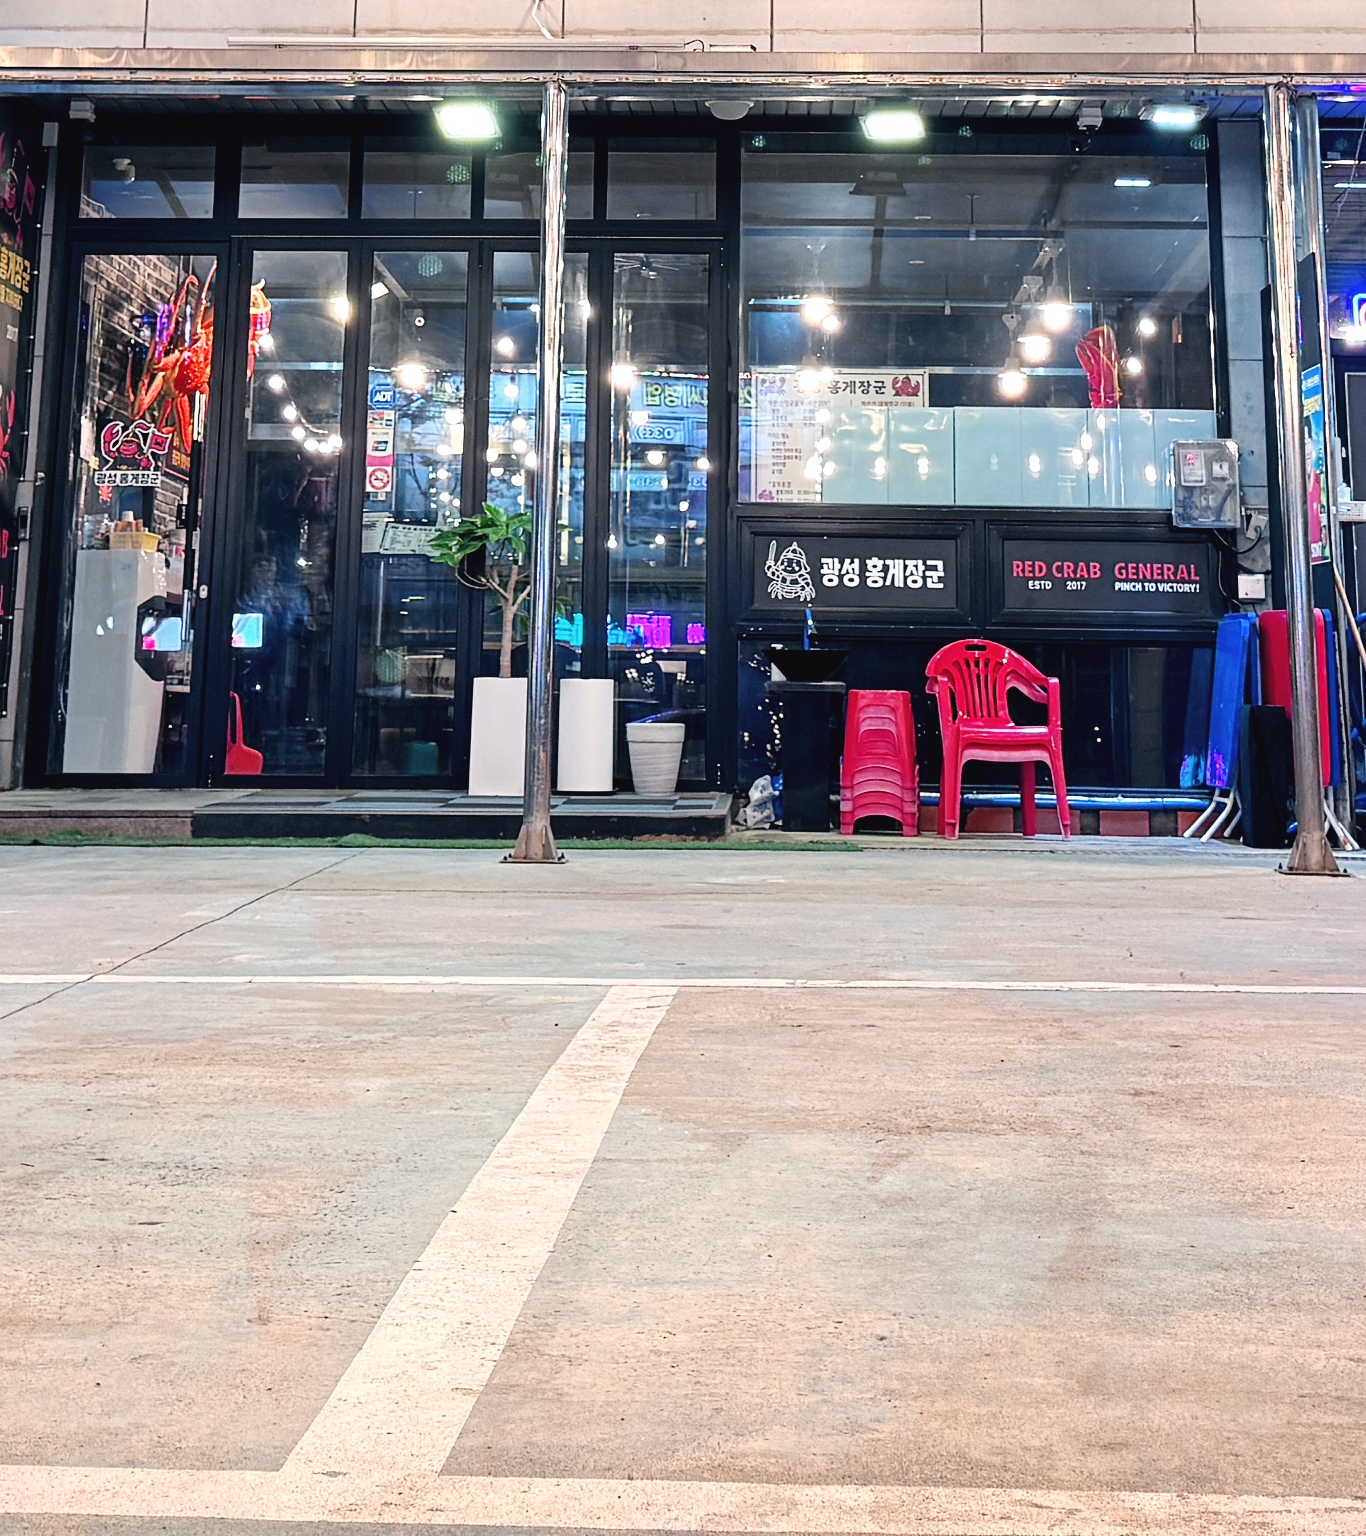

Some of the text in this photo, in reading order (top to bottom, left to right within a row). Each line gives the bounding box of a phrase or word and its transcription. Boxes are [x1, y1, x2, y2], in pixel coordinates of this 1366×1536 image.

[373, 392, 393, 402] ADT
[820, 557, 945, 589] 광성 홍게장군
[1012, 560, 1200, 580] RED CRAB GENERAL
[1028, 580, 1086, 590] ESTD 2017
[1114, 582, 1200, 593] PINCH TO VICTORY!
